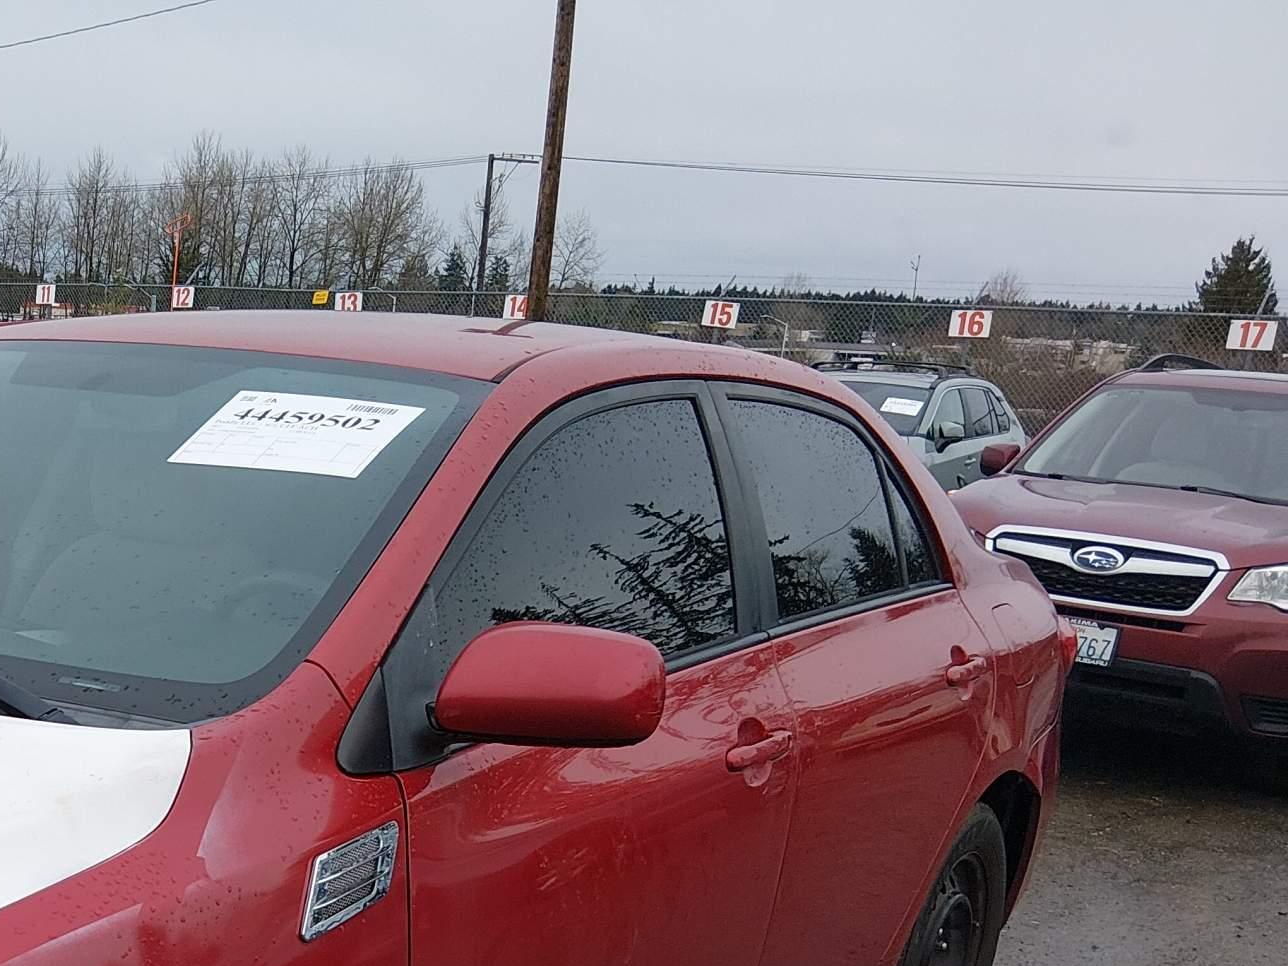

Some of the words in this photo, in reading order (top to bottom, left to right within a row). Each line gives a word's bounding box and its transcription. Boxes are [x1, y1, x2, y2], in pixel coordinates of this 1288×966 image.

[41, 286, 52, 302] 11
[175, 288, 191, 306] 12
[340, 293, 358, 311] 13
[510, 296, 528, 317] 14
[710, 302, 733, 327] 15
[957, 310, 985, 337] 16
[1239, 320, 1268, 348] 17
[233, 407, 381, 431] 44459502
[1077, 636, 1112, 659] 767
